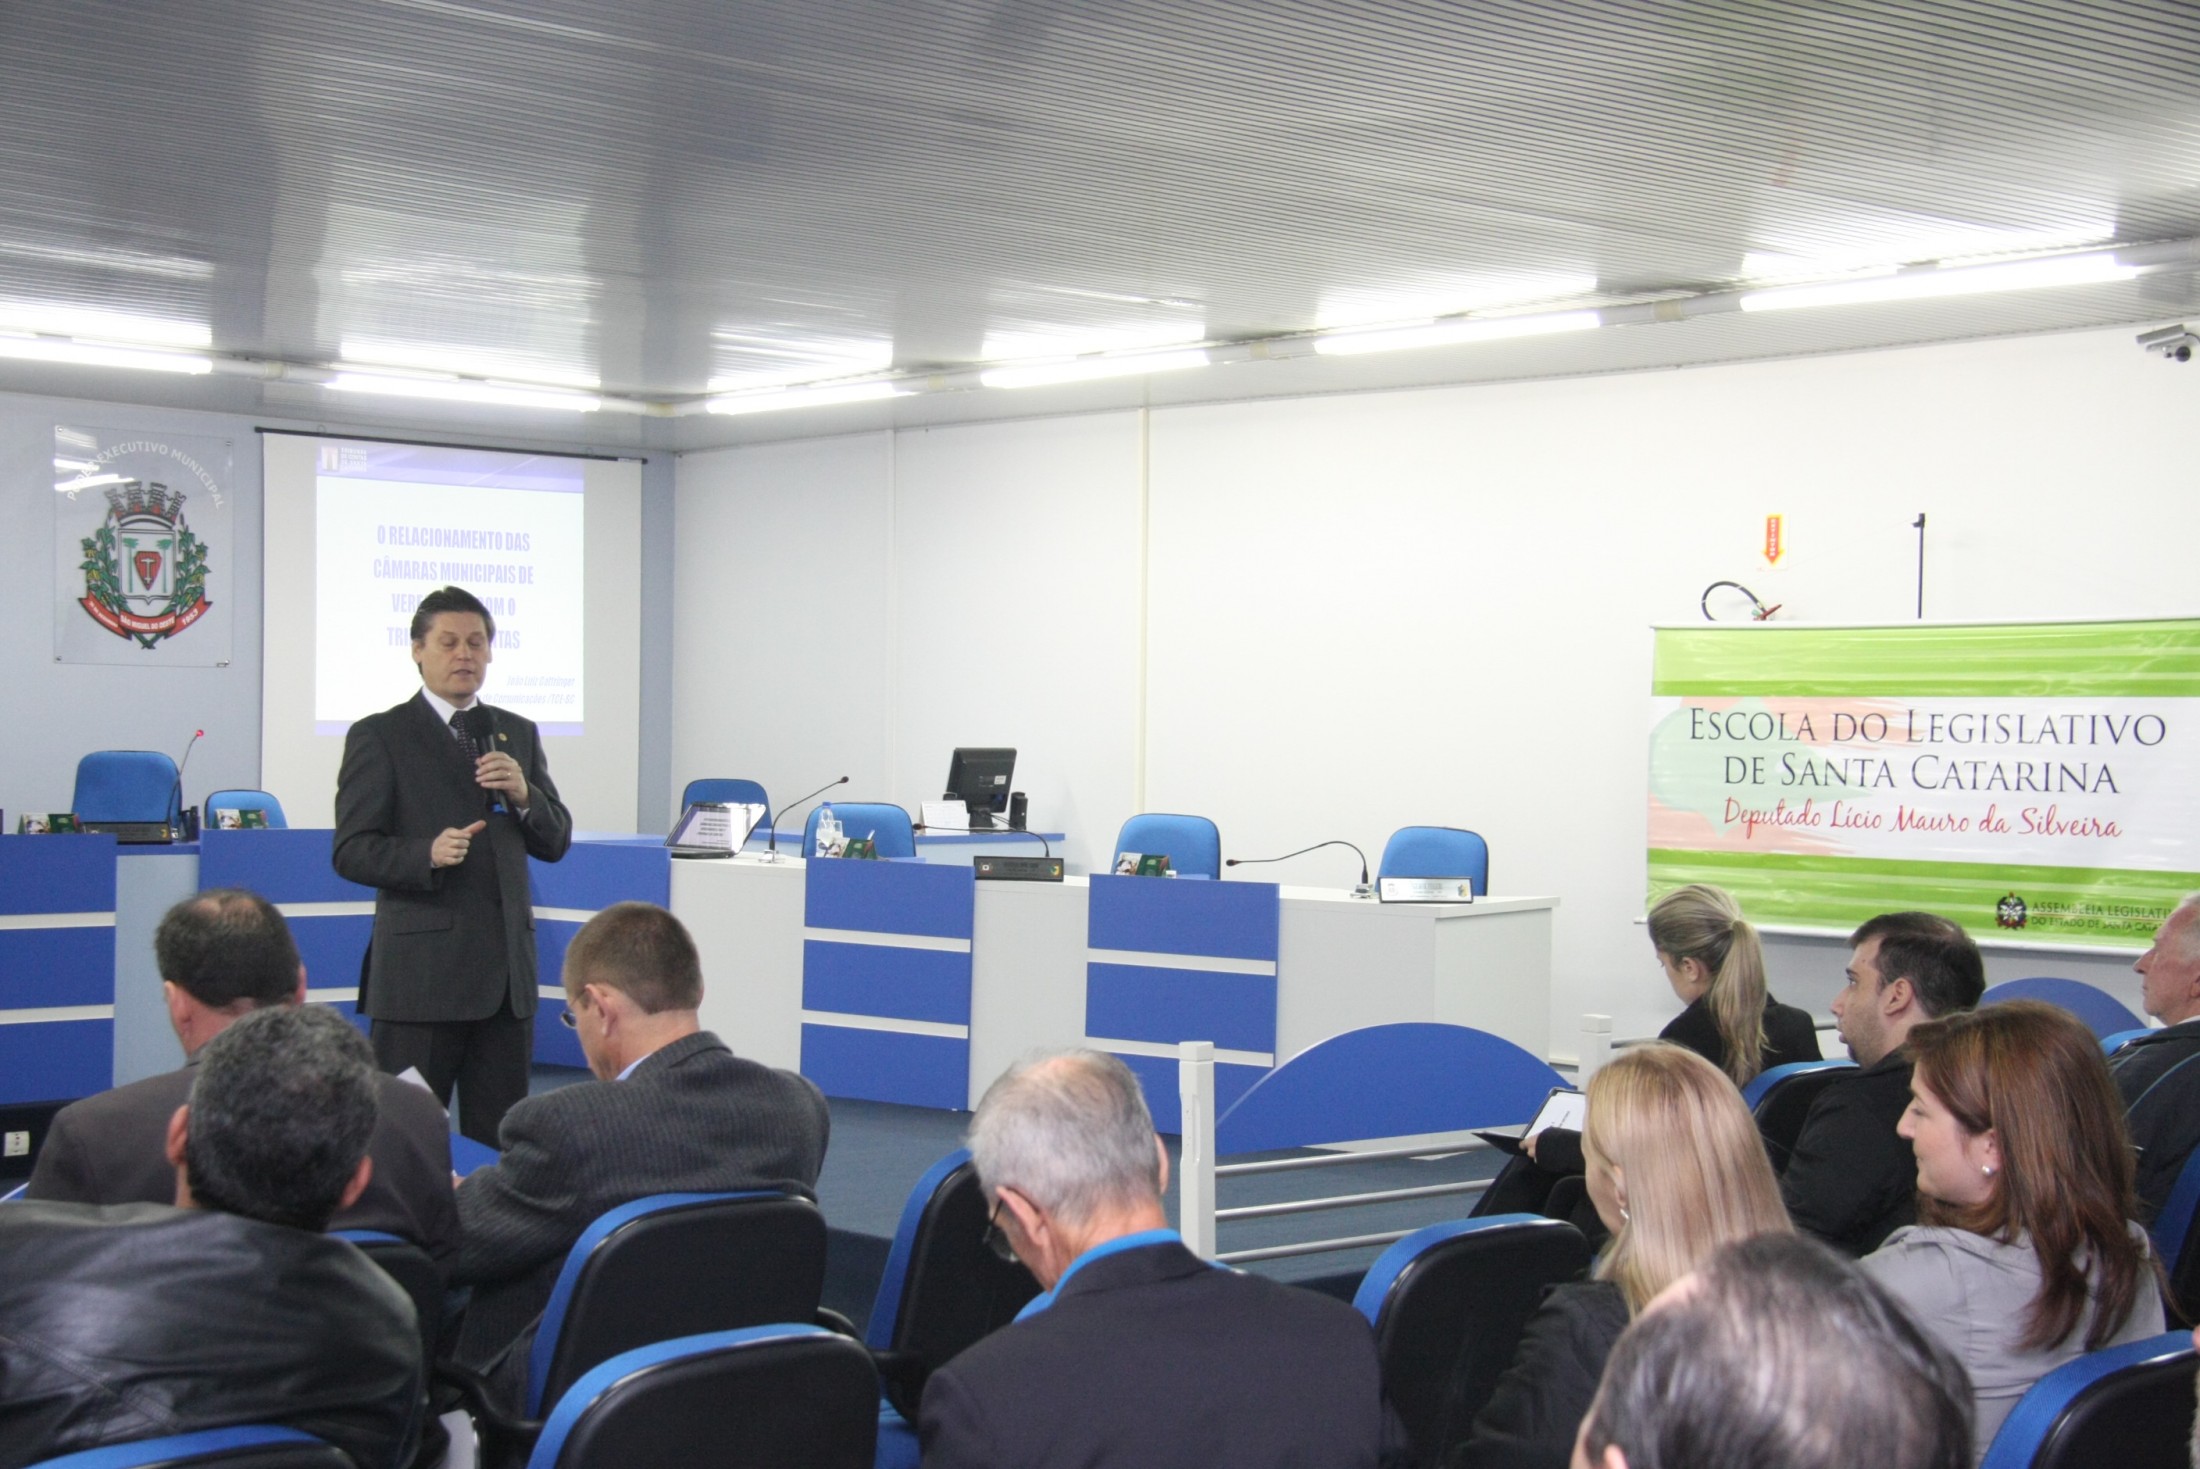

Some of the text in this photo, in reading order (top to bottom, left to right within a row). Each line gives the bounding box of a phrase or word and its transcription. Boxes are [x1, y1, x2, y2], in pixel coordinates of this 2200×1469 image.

[97, 441, 168, 464] EXECUTIVO
[171, 449, 225, 510] MUNICIPAL
[377, 525, 530, 552] O RELACIONAMENTO DAS
[373, 555, 534, 585] CÂMARAS MUNICIPAIS DE
[508, 597, 516, 617] O
[386, 626, 411, 647] TRI
[1690, 707, 2166, 746] ESCOLA DO LEGISLATIVO
[1724, 752, 2121, 794] DE SANTA CATARINA
[1724, 796, 2123, 839] Deputado Lício Mauro da Silveira
[2031, 916, 2047, 926] DO
[2088, 919, 2100, 929] DE
